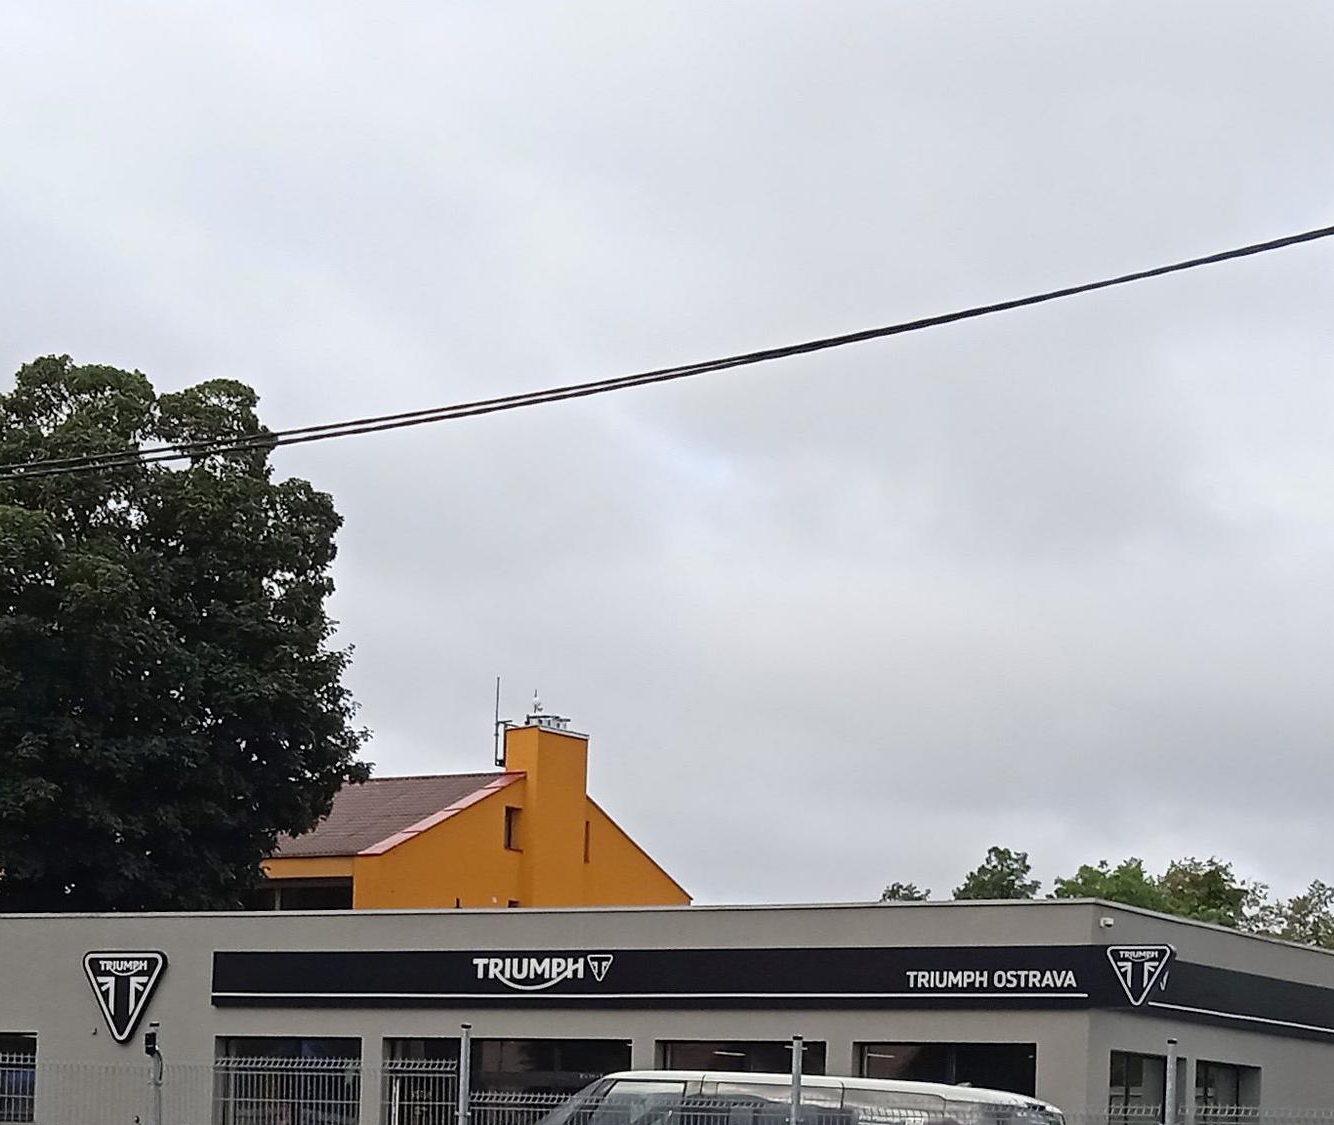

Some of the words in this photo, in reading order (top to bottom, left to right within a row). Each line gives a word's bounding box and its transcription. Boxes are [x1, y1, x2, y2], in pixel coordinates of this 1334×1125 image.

[1119, 950, 1159, 962] TRIUMPH
[99, 960, 148, 976] TRIUMPH
[473, 957, 585, 990] TRIUMPH
[906, 970, 988, 988] TRIUMPH
[993, 970, 1077, 988] OSTRAVA
